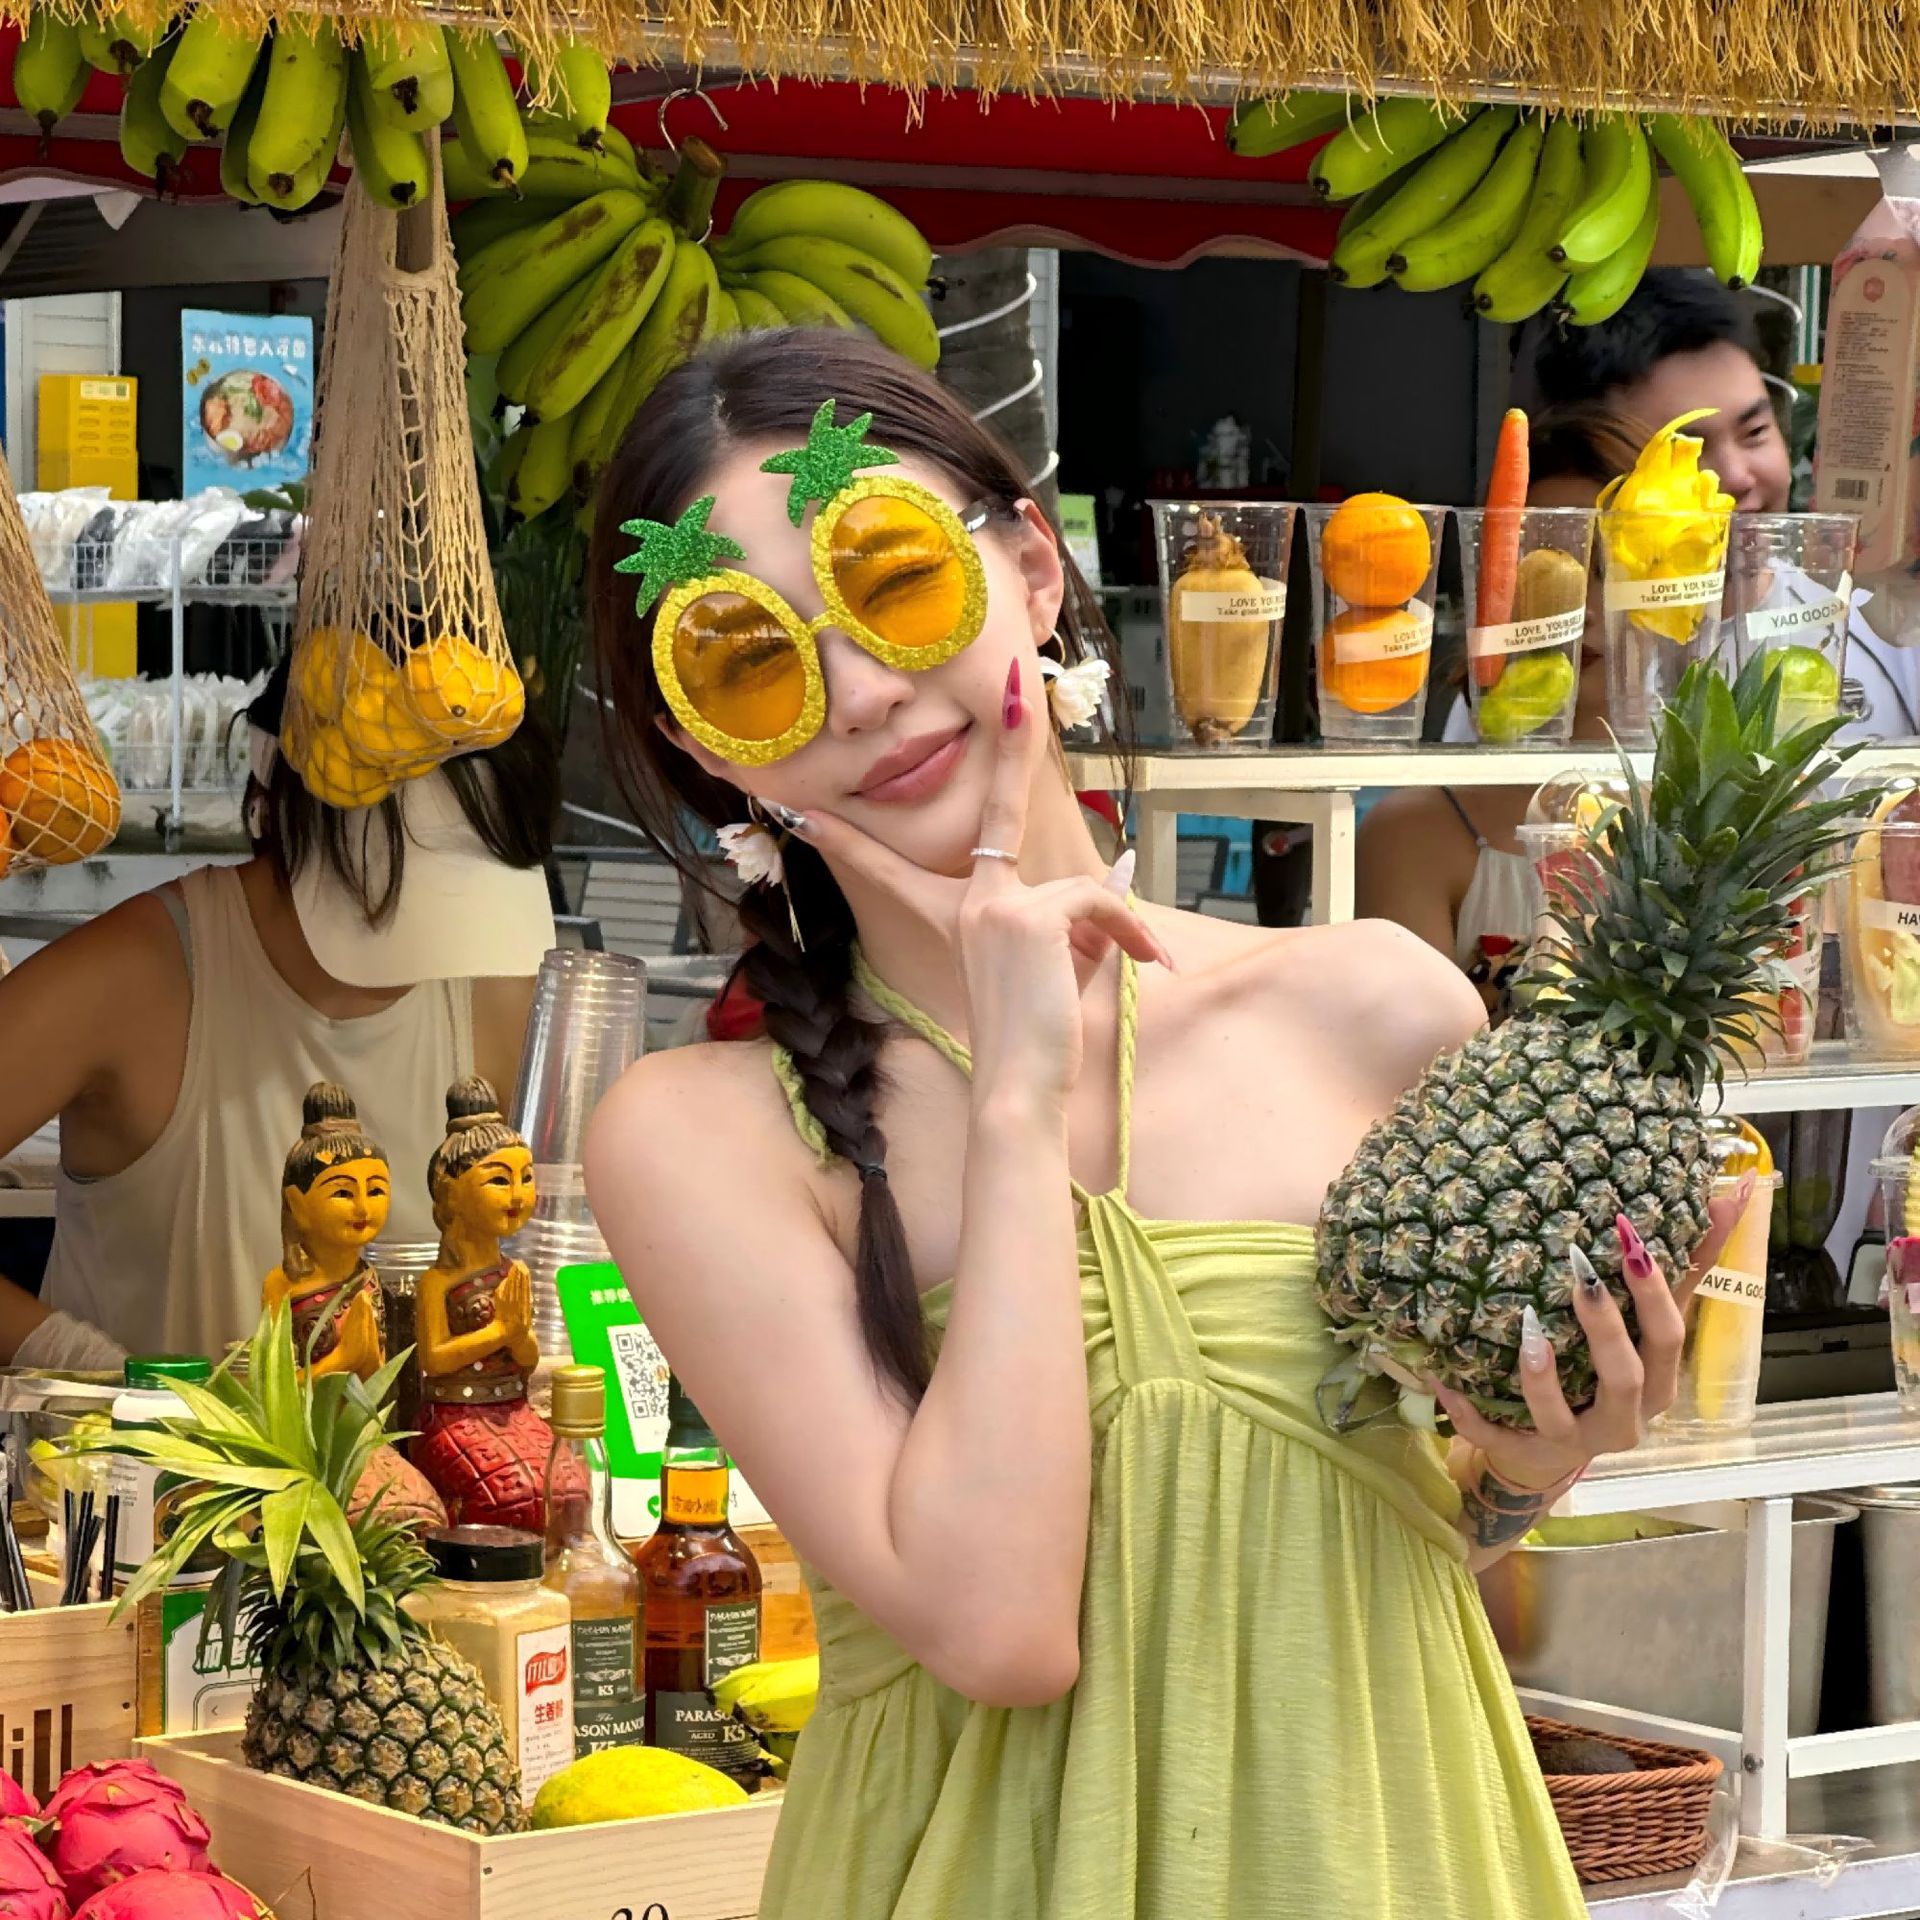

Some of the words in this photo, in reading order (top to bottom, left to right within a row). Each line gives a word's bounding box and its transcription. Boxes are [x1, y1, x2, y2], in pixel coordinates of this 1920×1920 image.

[1650, 584, 1678, 595] LOVE
[1230, 597, 1257, 608] LOVE
[1515, 625, 1541, 638] LOVE
[1897, 911, 1920, 926] HA
[1734, 1281, 1743, 1294] A
[598, 1684, 614, 1697] K5
[690, 1731, 716, 1740] AGED
[722, 1723, 746, 1743] K5
